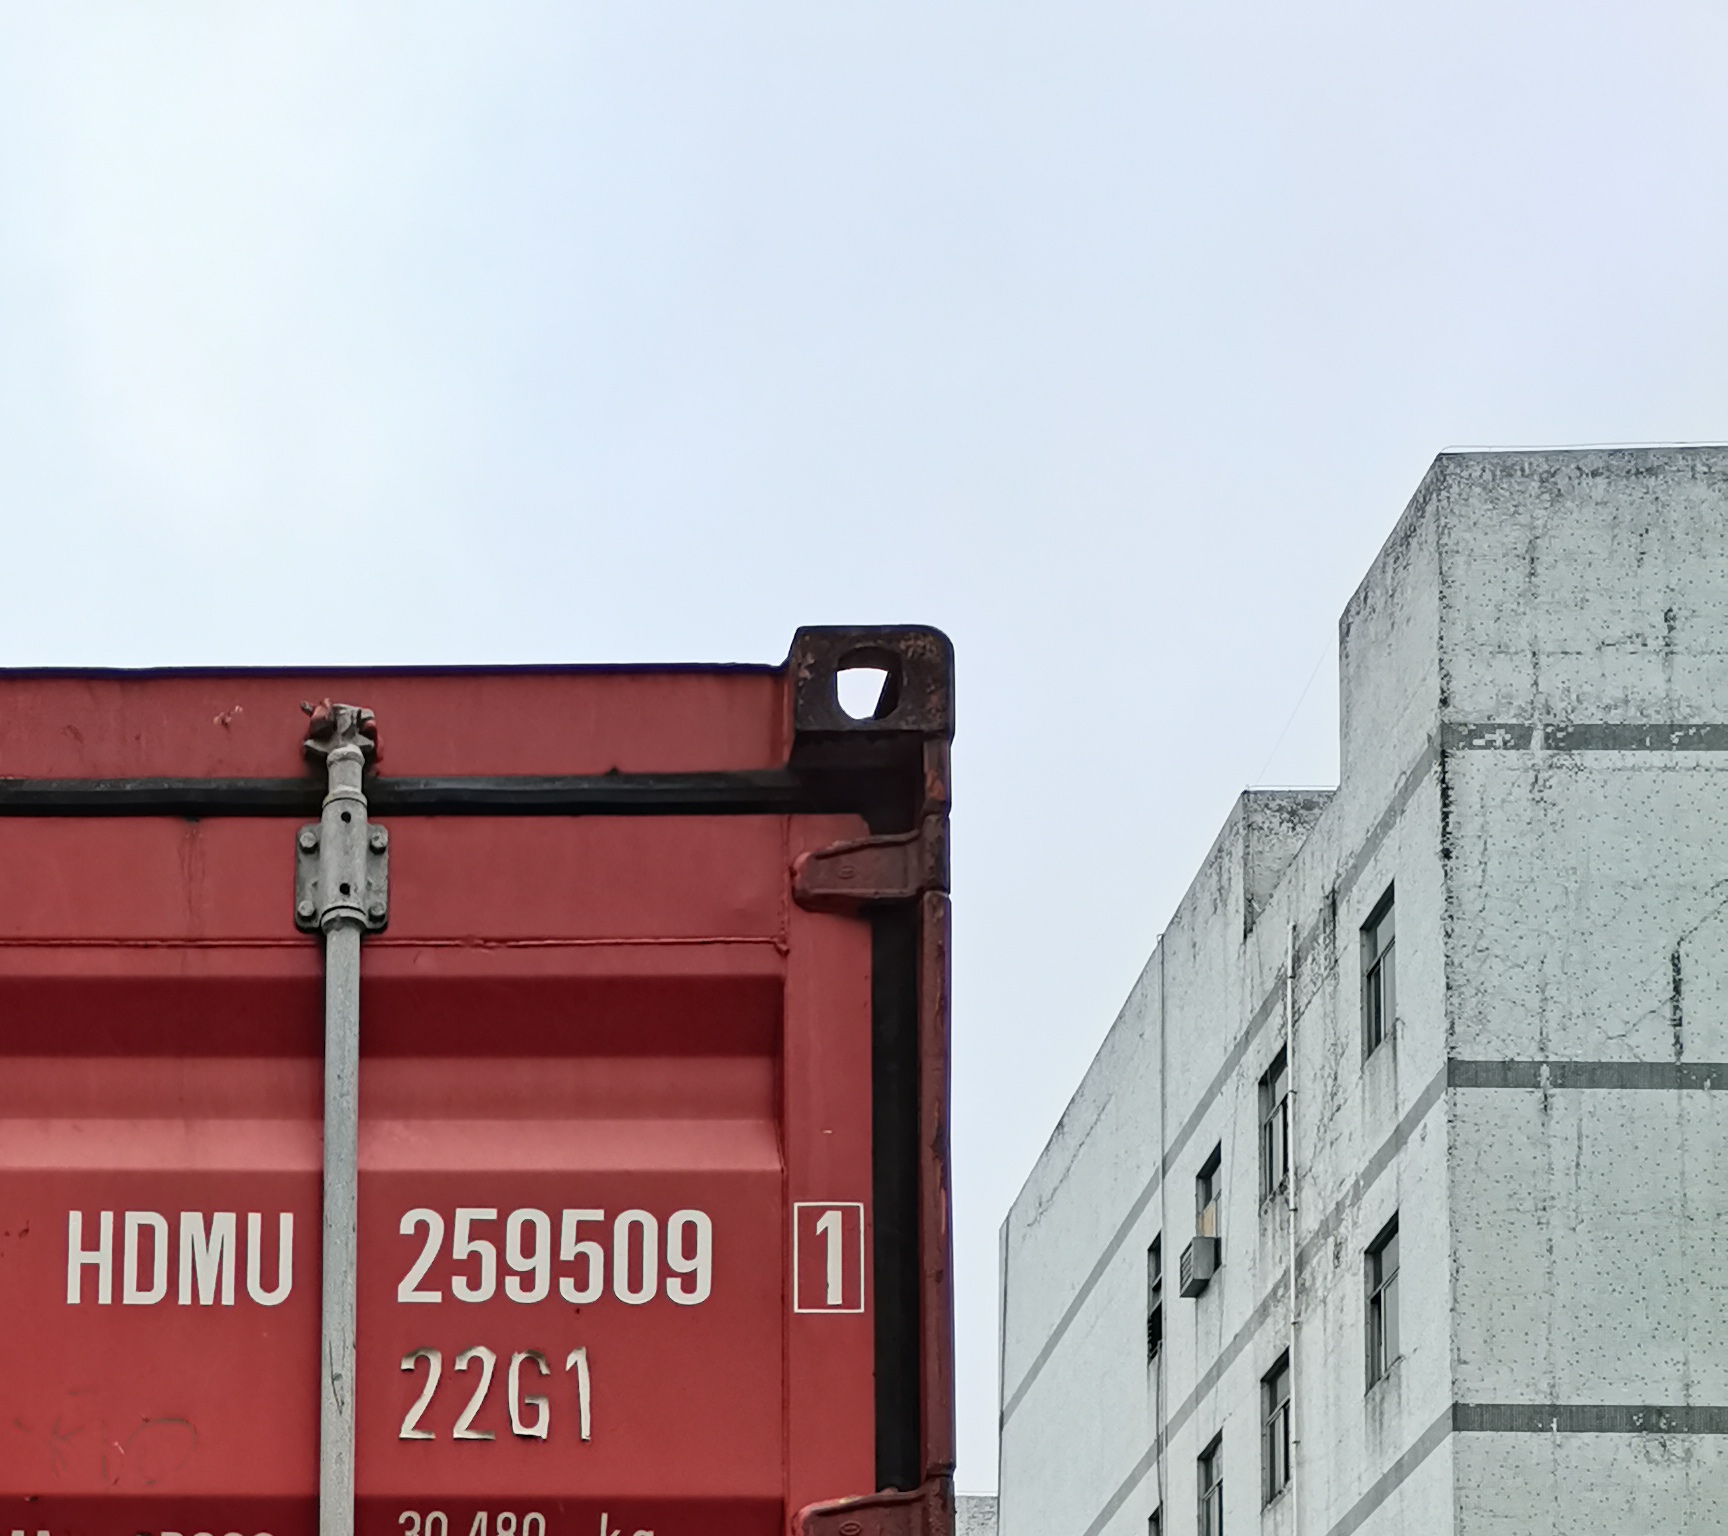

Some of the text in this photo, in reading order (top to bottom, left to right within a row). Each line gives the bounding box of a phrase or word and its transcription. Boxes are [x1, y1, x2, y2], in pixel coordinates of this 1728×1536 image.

[67, 1208, 843, 1306] HDMU 259509 1
[398, 1345, 593, 1442] 22G1
